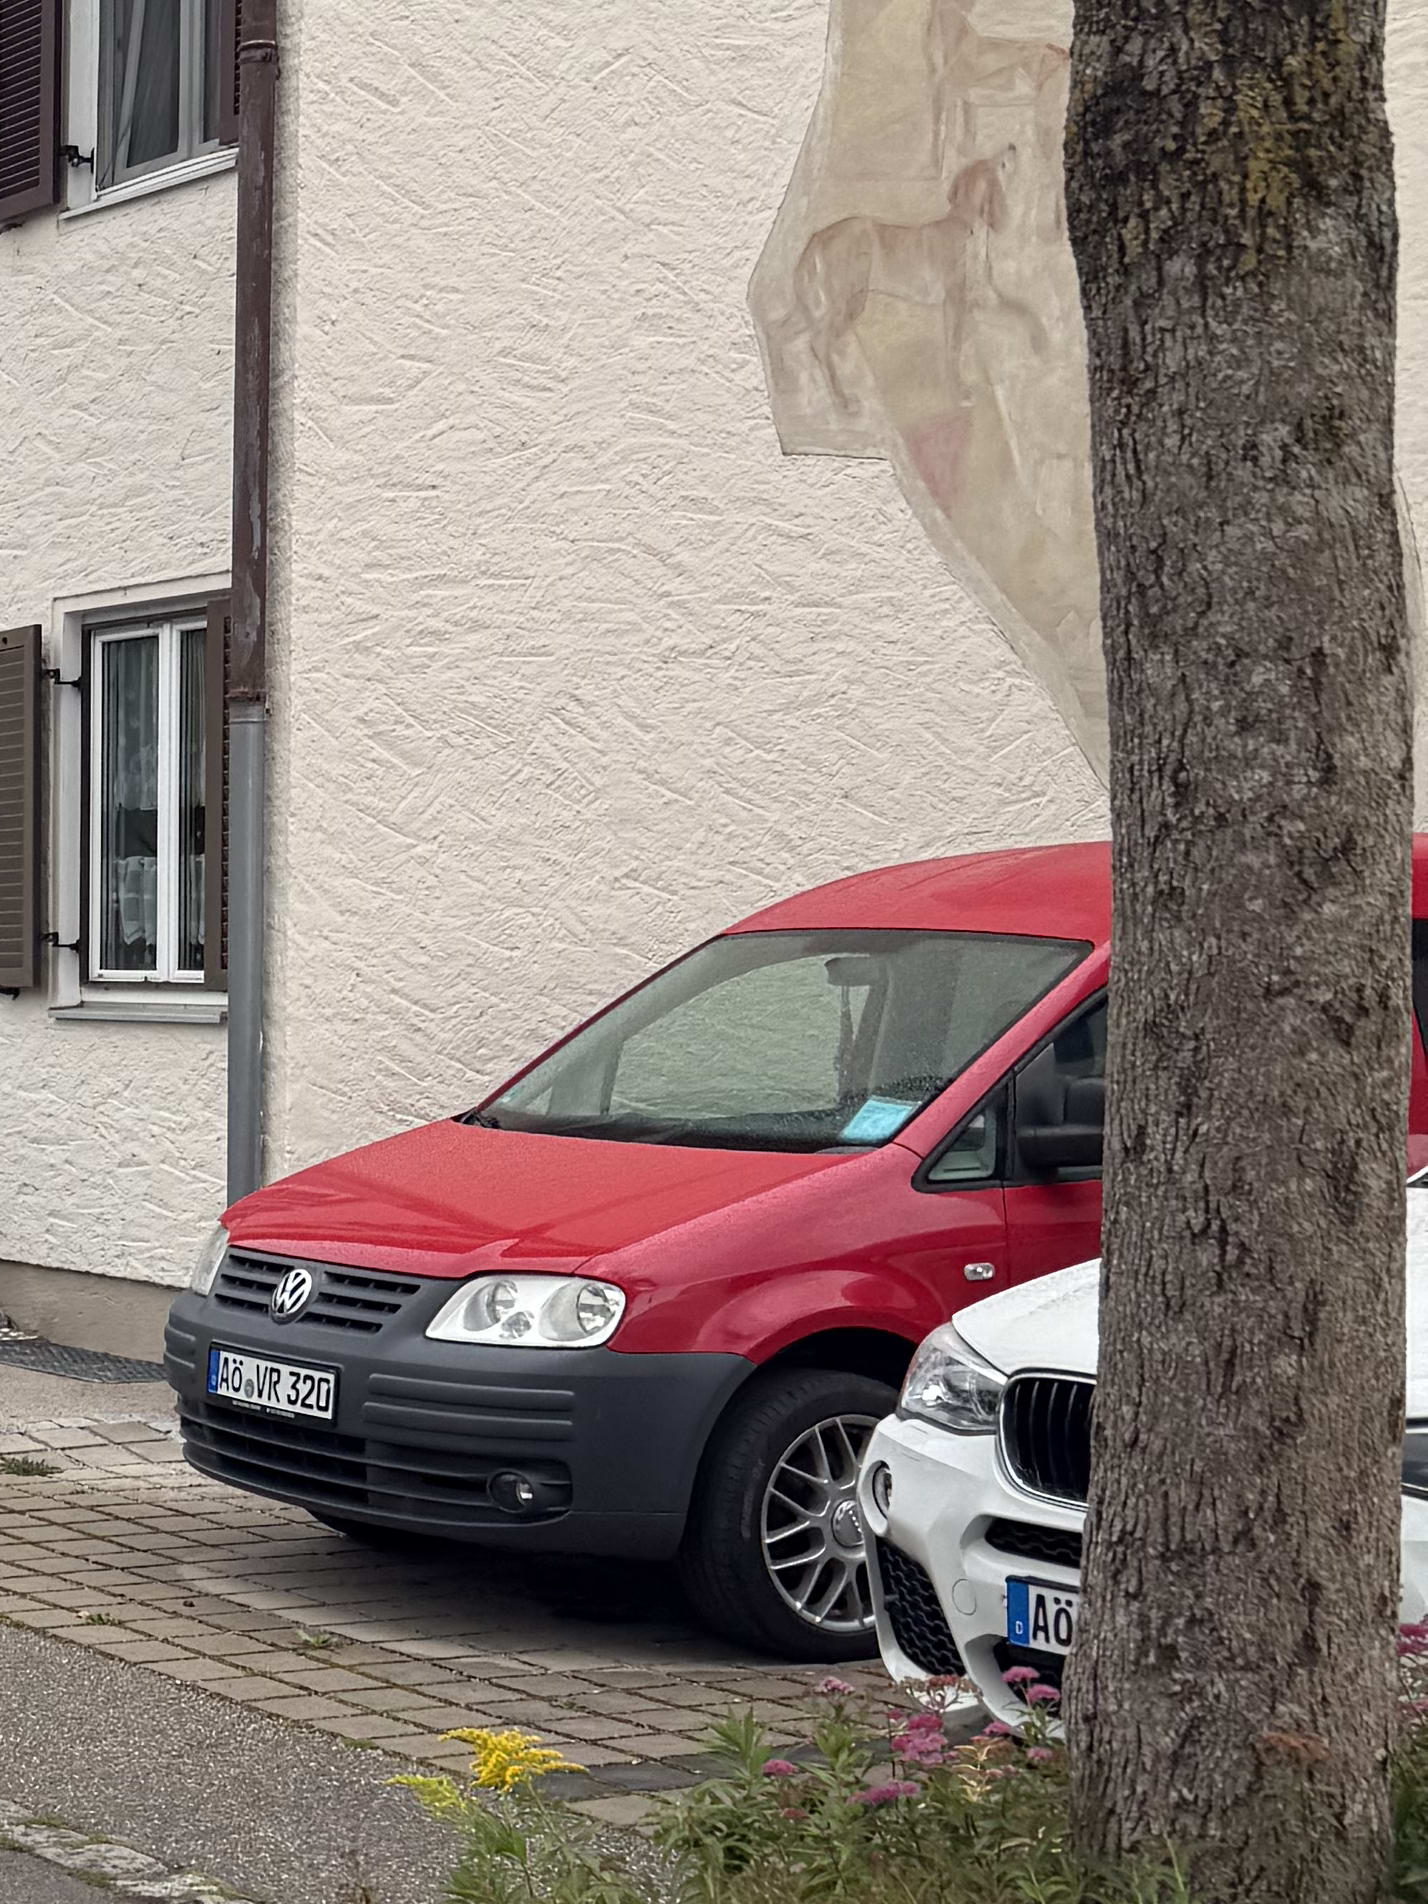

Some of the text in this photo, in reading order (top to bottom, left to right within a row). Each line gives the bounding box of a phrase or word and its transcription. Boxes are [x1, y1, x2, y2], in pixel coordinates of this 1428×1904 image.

[219, 1357, 243, 1393] AÖ
[256, 1364, 280, 1403] VR
[287, 1371, 331, 1412] 320
[1015, 1621, 1023, 1634] D
[1032, 1594, 1073, 1647] AÖ
